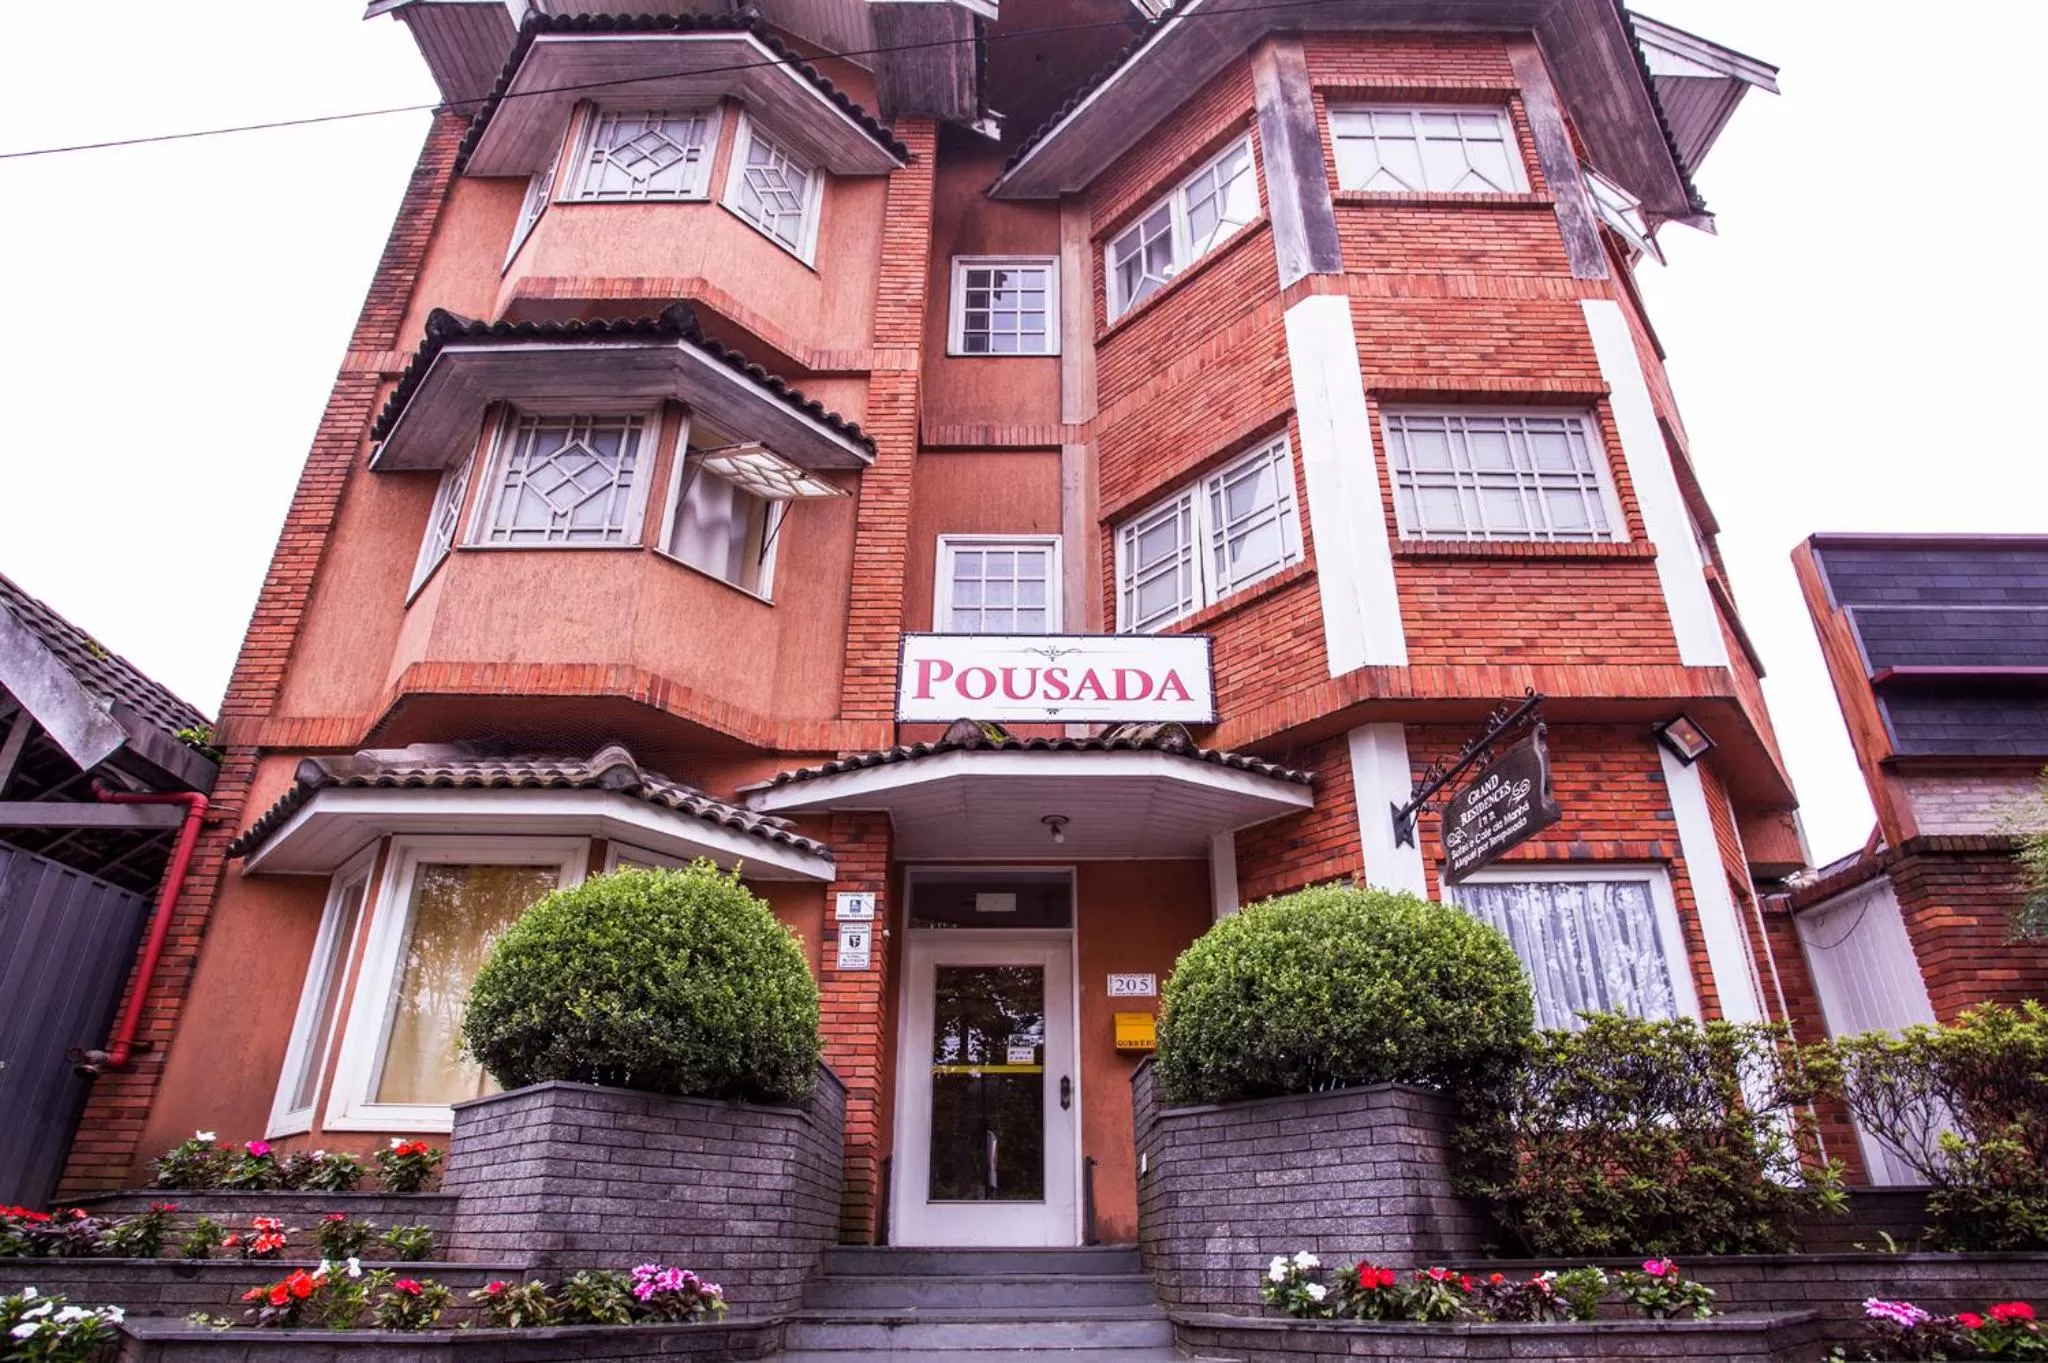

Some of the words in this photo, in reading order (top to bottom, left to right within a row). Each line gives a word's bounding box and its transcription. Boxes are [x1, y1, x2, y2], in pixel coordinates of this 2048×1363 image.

[912, 659, 1193, 702] POUSADA
[1460, 780, 1511, 827] RESIDENCES
[1468, 774, 1499, 805] GRAND
[1115, 978, 1149, 992] 205
